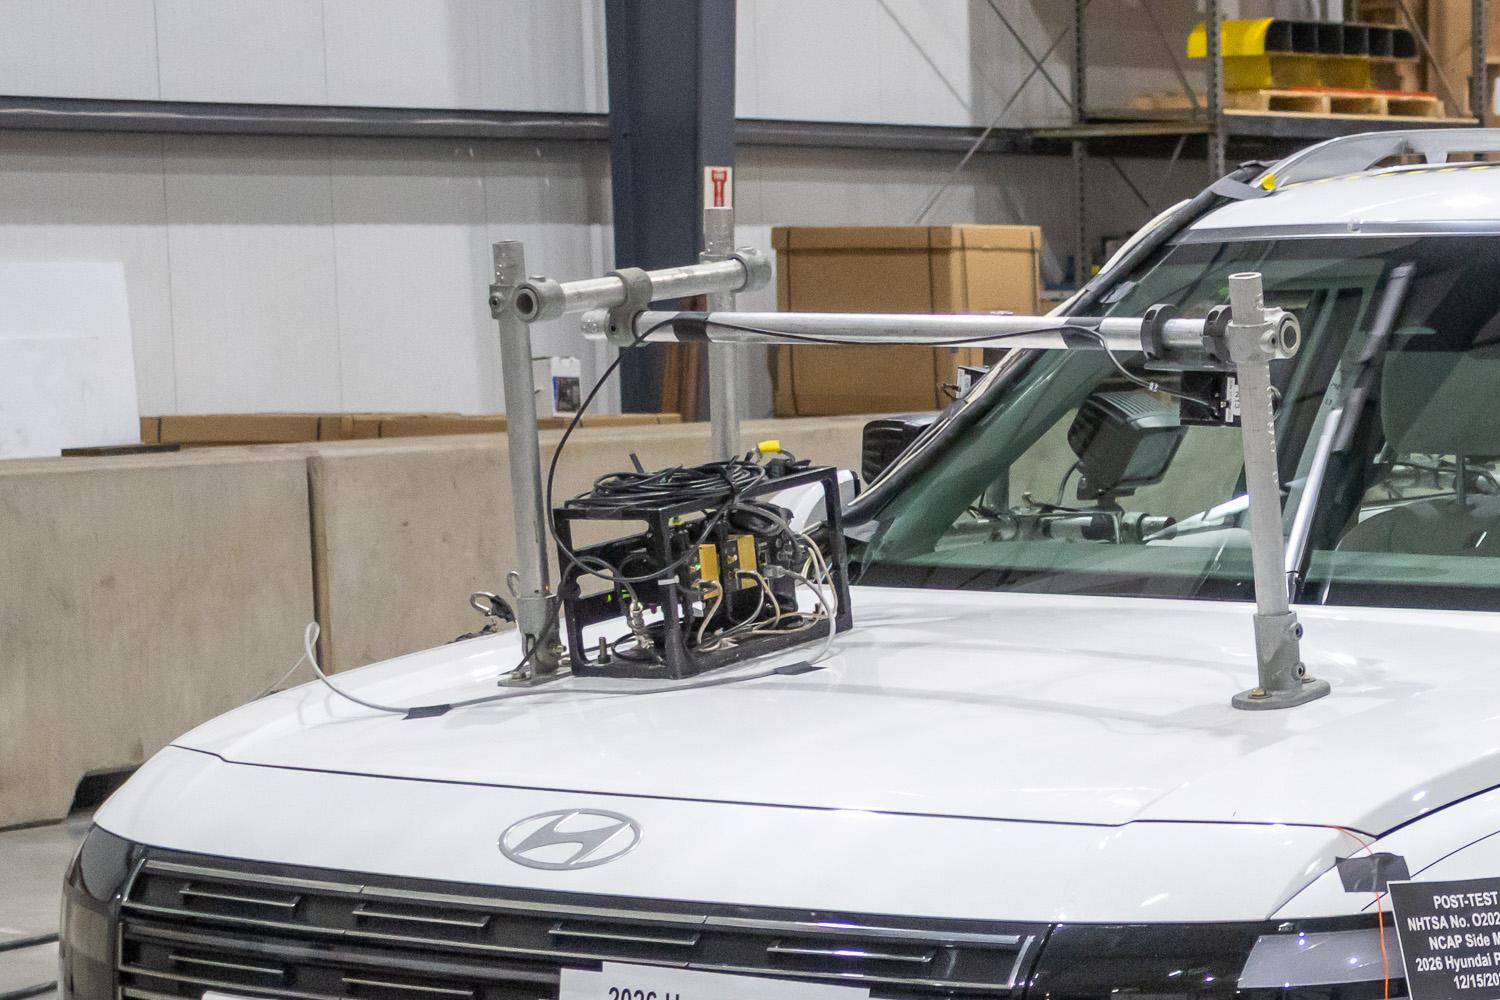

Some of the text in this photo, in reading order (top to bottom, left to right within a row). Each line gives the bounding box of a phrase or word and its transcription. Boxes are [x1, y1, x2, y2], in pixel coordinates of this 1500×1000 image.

[1433, 891, 1498, 909] POST-TEST
[1407, 915, 1449, 932] NHTSA
[1450, 914, 1470, 929] No.
[1429, 935, 1462, 950] NCAP
[1466, 933, 1490, 948] Side
[1416, 957, 1443, 972] 2026
[1445, 953, 1492, 973] Hyundai
